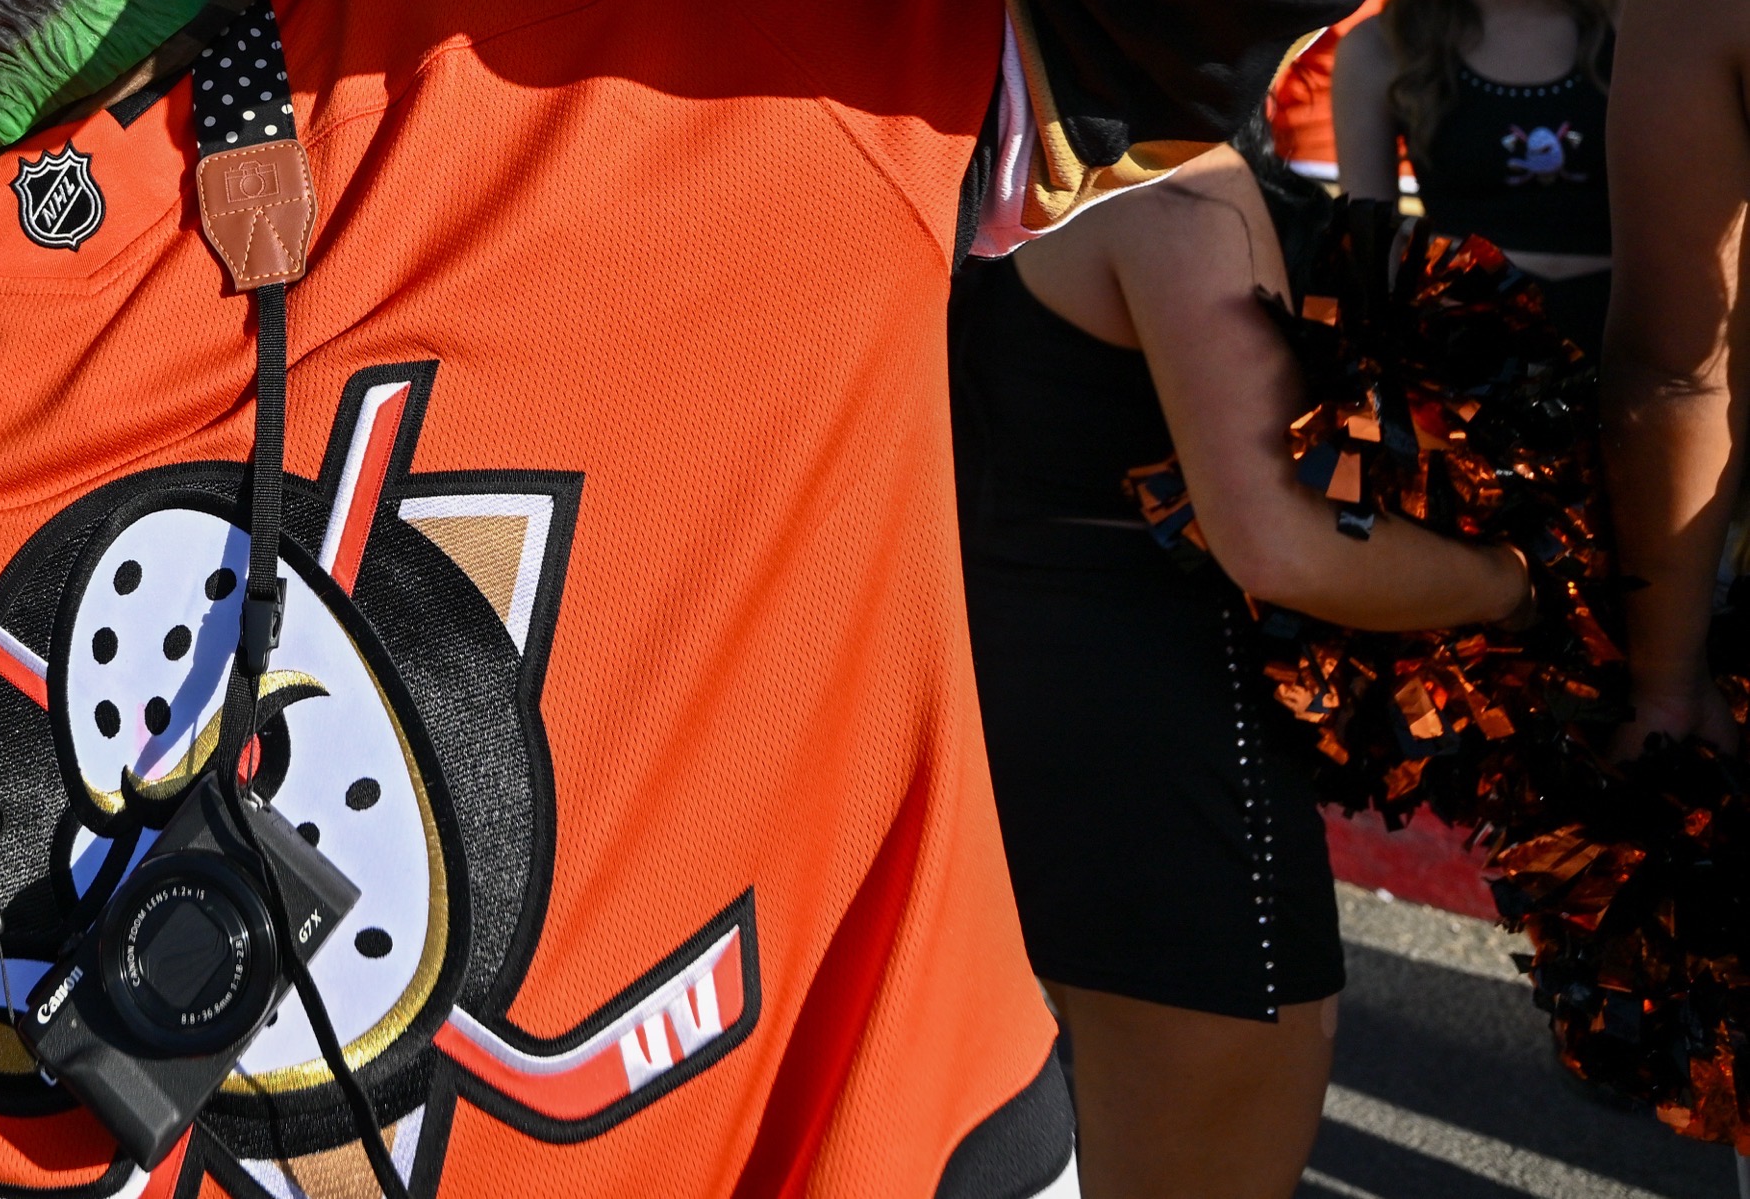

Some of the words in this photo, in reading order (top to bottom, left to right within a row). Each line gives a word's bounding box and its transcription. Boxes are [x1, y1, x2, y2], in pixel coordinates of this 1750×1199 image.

[40, 174, 76, 229] NHL
[145, 890, 169, 912] LENS
[128, 908, 147, 944] ZOOM
[127, 945, 141, 988] CANON
[36, 964, 84, 1025] Canon
